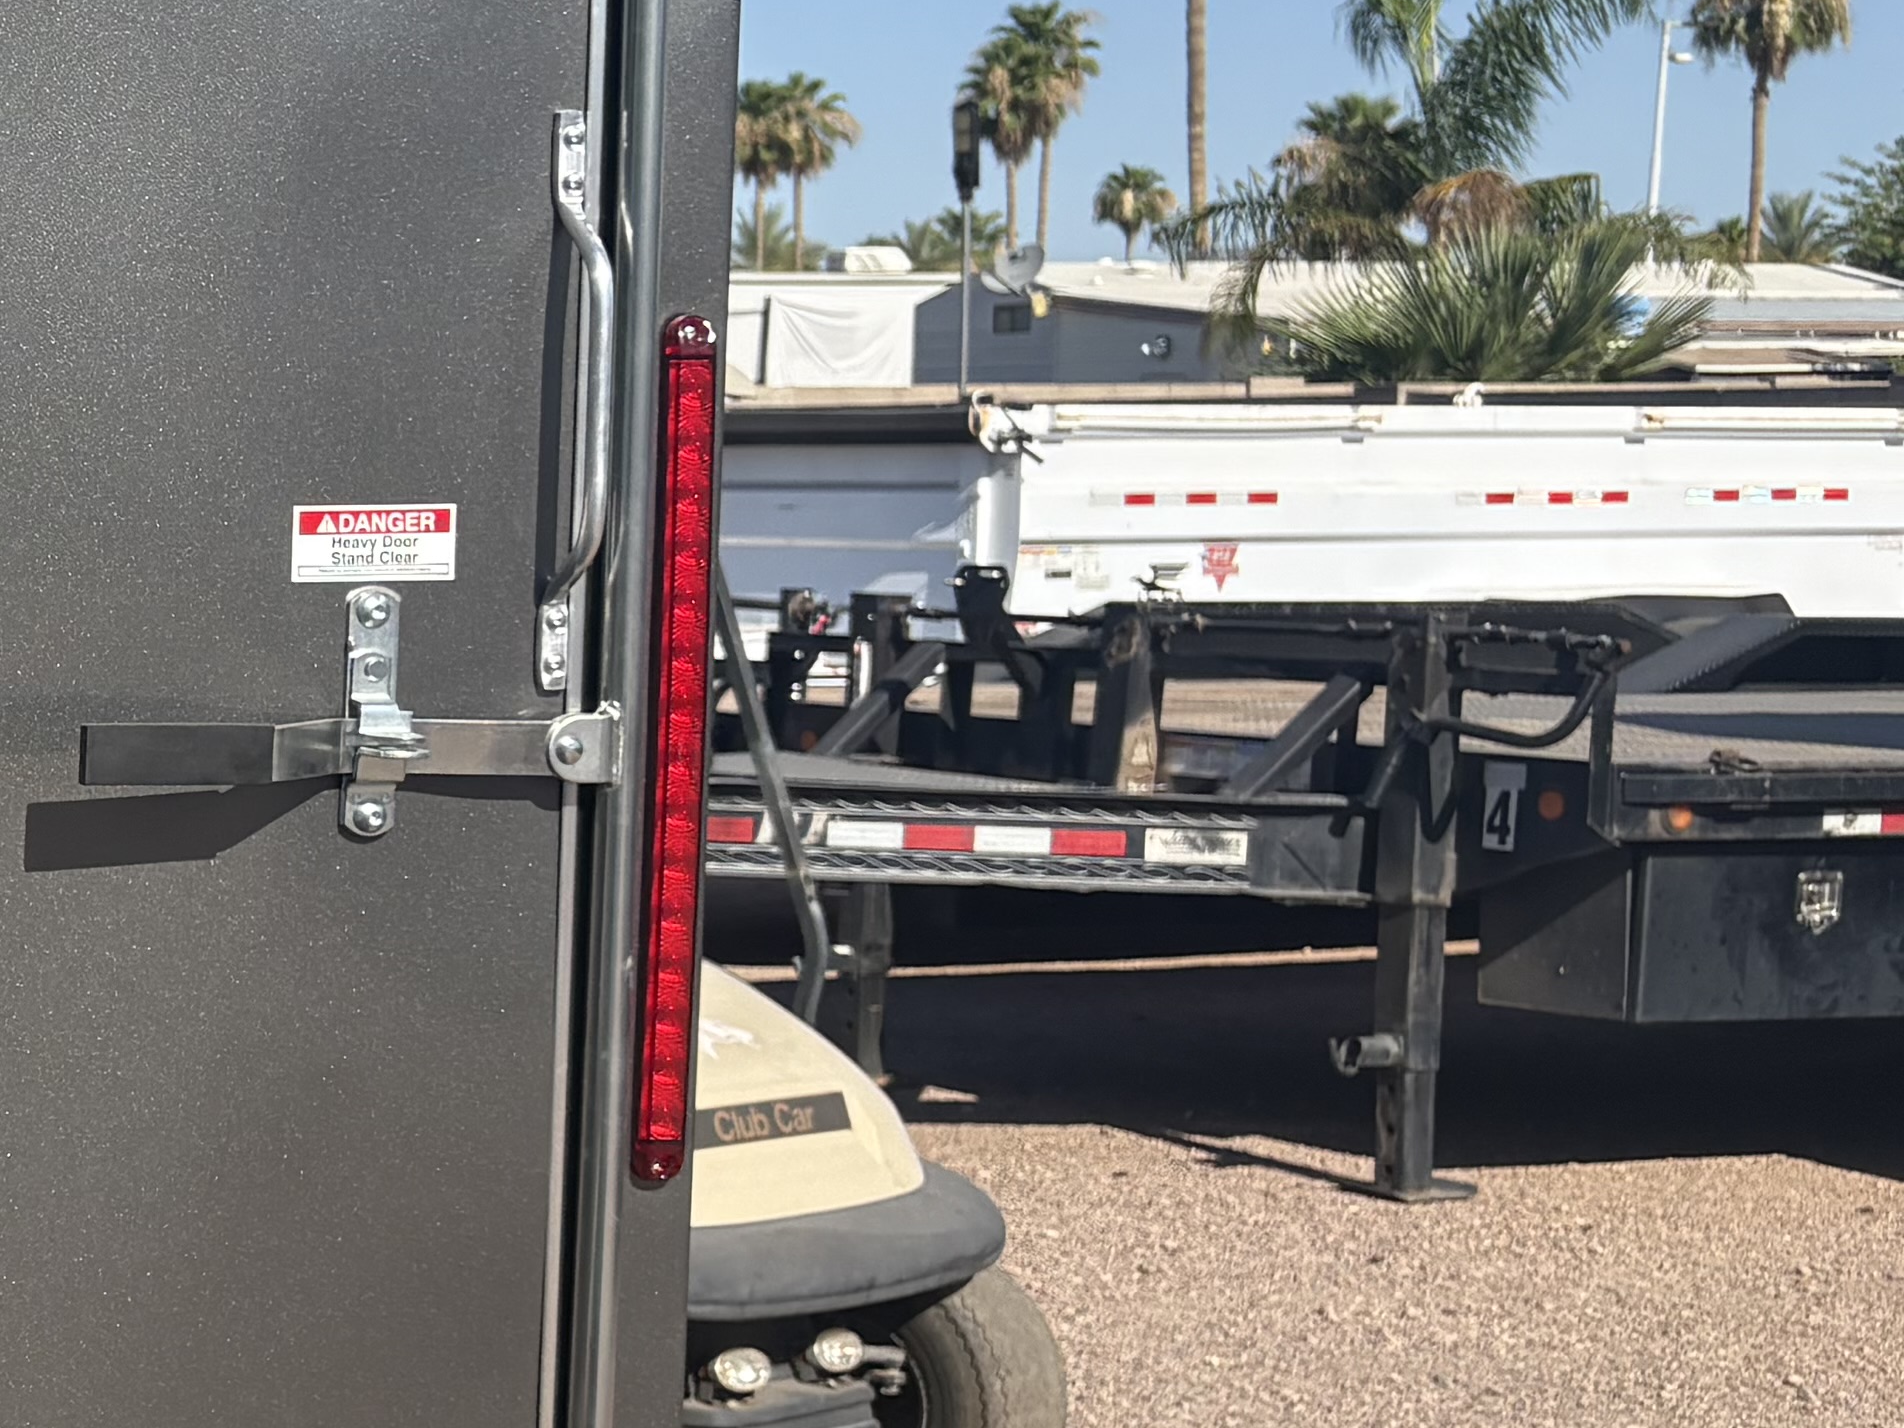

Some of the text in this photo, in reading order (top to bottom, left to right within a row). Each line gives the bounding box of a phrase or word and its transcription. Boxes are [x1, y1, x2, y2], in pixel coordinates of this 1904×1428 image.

[338, 511, 436, 533] DANGER
[331, 535, 418, 552] Heavy Door
[331, 551, 419, 566] Stand Clear
[1486, 790, 1512, 846] 4
[713, 1101, 815, 1142] Club Car
